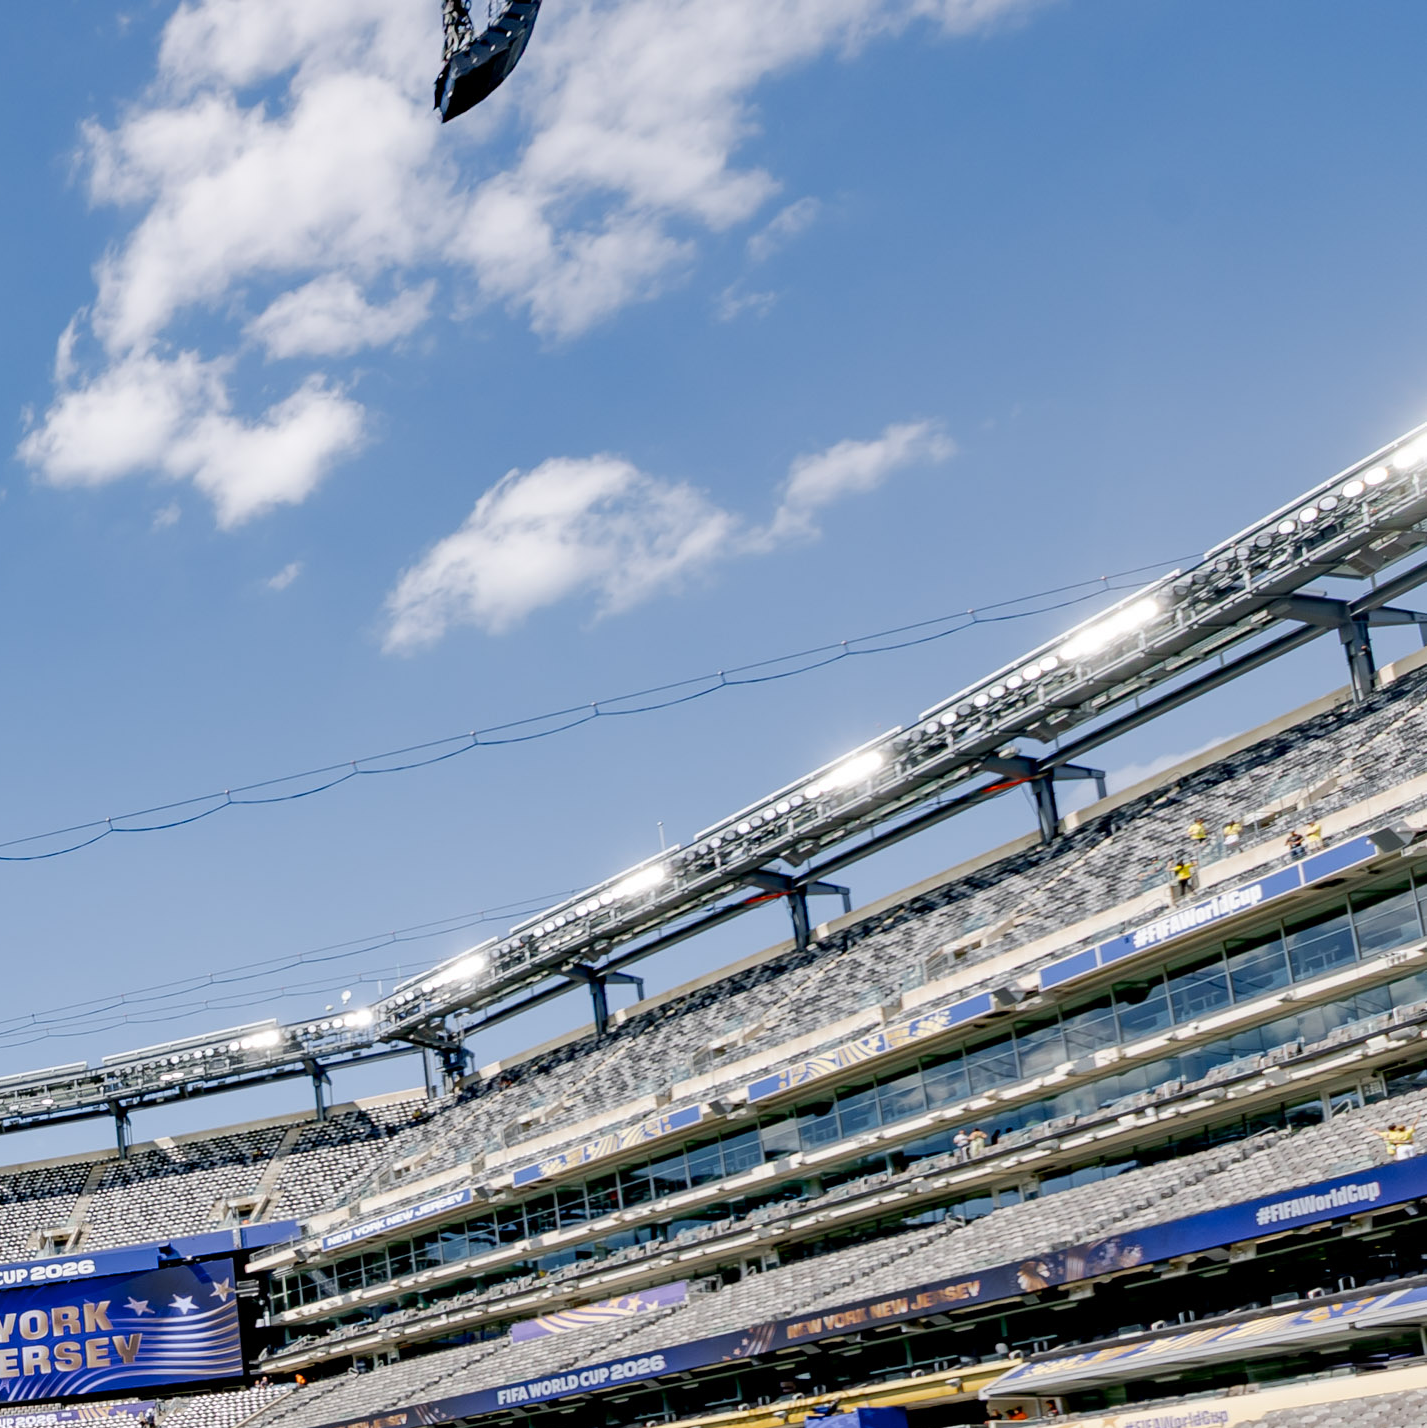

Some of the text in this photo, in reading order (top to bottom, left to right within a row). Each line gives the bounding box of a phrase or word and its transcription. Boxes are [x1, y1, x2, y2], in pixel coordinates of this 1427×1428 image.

[1133, 884, 1262, 949] #FIFAWorldCup
[327, 1192, 465, 1247] NEW YORK NEW JERSEY
[1255, 1181, 1381, 1226] #FIFAWorldCup
[29, 1259, 96, 1280] 2026
[786, 1280, 981, 1340] NEW YORK NEW JERSEY
[497, 1354, 666, 1405] FIFA WORLD CUP 2026
[15, 1413, 57, 1425] 2026
